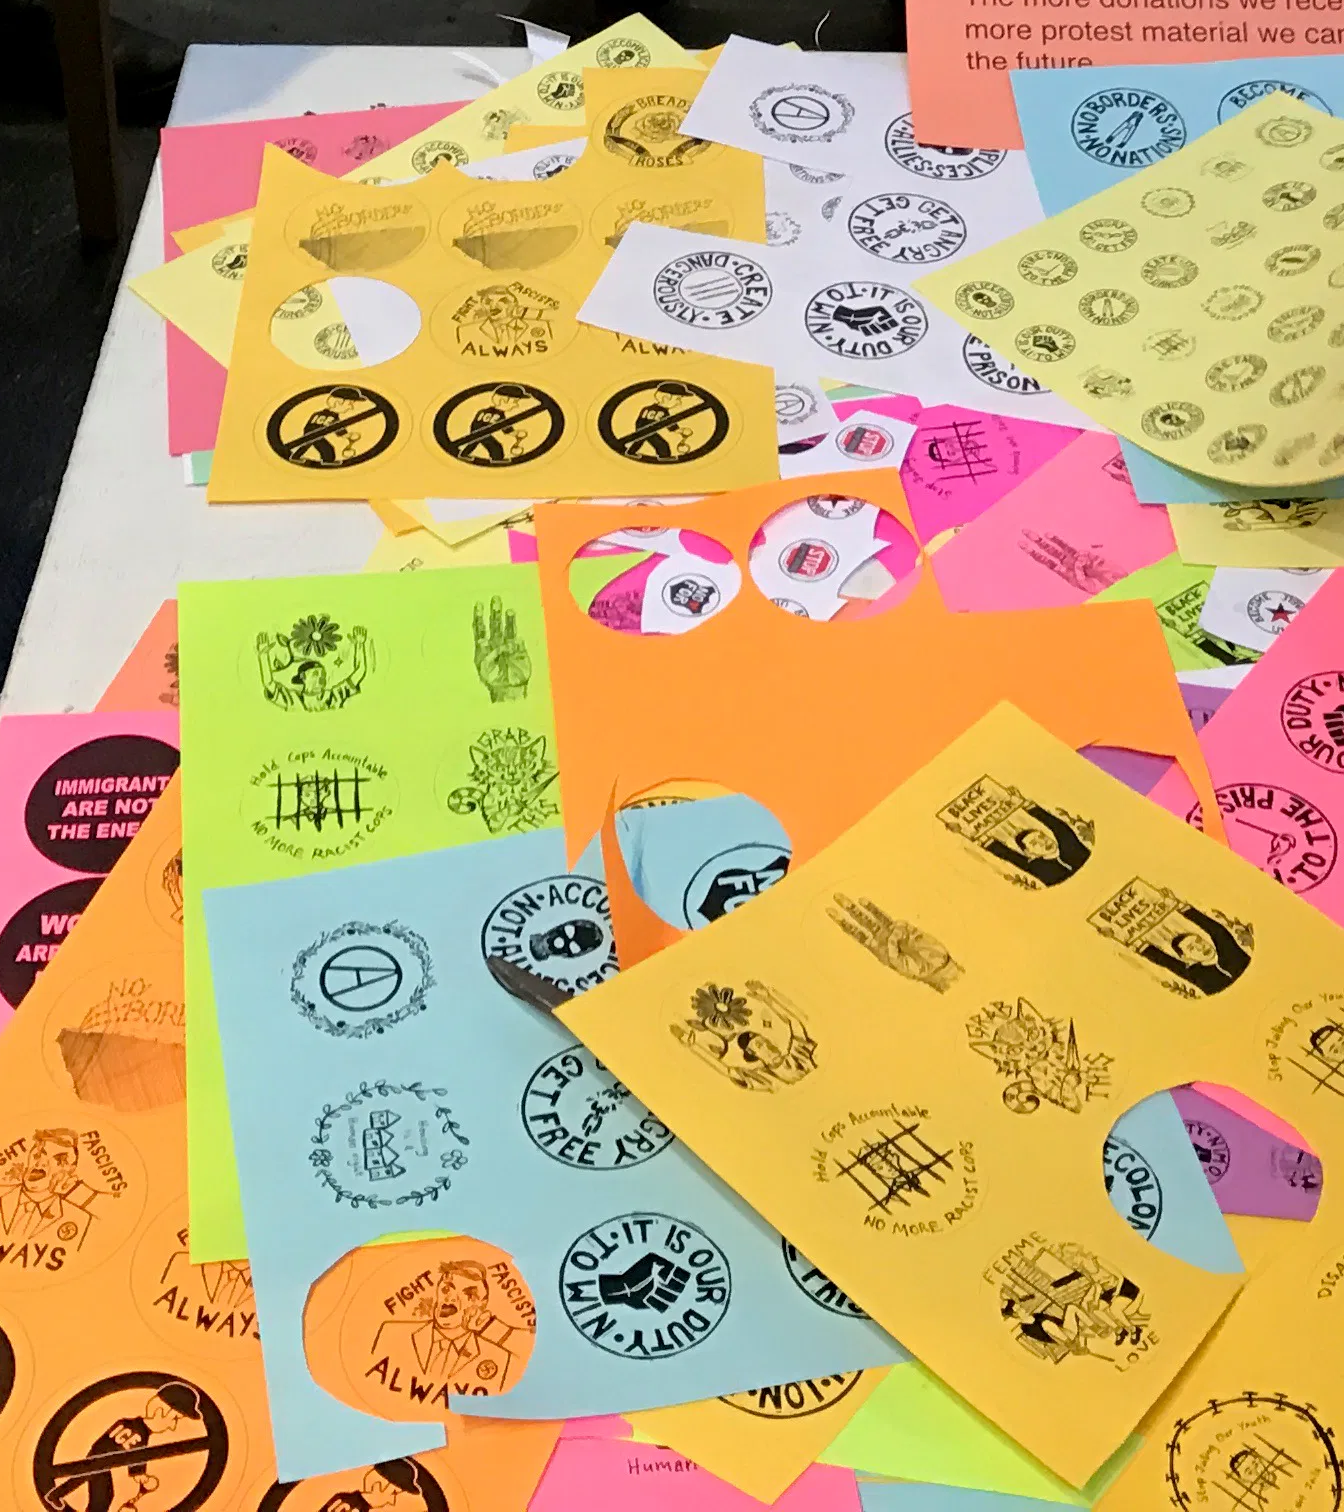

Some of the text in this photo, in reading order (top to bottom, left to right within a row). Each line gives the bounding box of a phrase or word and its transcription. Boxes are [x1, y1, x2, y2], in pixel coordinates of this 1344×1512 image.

[965, 22, 1032, 40] more
[1041, 20, 1133, 46] protest
[1142, 20, 1249, 43] material
[1257, 26, 1295, 44] we
[965, 50, 1093, 71] the future
[635, 94, 689, 110] BREAD
[1092, 91, 1177, 132] BORDERS
[635, 154, 685, 168] ROSES
[852, 196, 963, 262] GET ANGRY GET FREE
[451, 280, 560, 324] FIGHT FASCISTS
[657, 253, 769, 326] CREATE DANGEROUSLY
[808, 282, 917, 358] IT IS OUR DUTY TO WIN
[460, 340, 549, 358] ALWAYS
[968, 350, 1042, 392] PRISON
[1164, 588, 1204, 616] BLACK
[1286, 678, 1328, 730] DUTY
[476, 726, 532, 746] GRAB
[287, 747, 390, 781] Cops Accountable
[61, 797, 158, 818] ARE NOT
[946, 787, 986, 819] BLACK
[962, 795, 999, 824] LIVES
[973, 799, 1016, 831] MATTER
[47, 824, 92, 841] THE
[267, 806, 394, 860] MORE RACIST COPS
[1279, 792, 1332, 883] TO THE
[490, 897, 543, 938] NOT
[1099, 887, 1138, 923] BLACK
[1115, 896, 1153, 929] LIVES
[1126, 899, 1172, 937] MATTER
[1082, 1051, 1116, 1103] THIS
[529, 1054, 602, 1165] GET FREE
[815, 1102, 933, 1185] Hold Cops Accountable
[863, 1140, 980, 1237] NO MORE RACIST COPS
[981, 1229, 1049, 1287] FEMME
[383, 1270, 435, 1316] FIGHT
[565, 1219, 727, 1356] IT IS OUR DUTY TO WIN
[1114, 1332, 1163, 1374] LOVE
